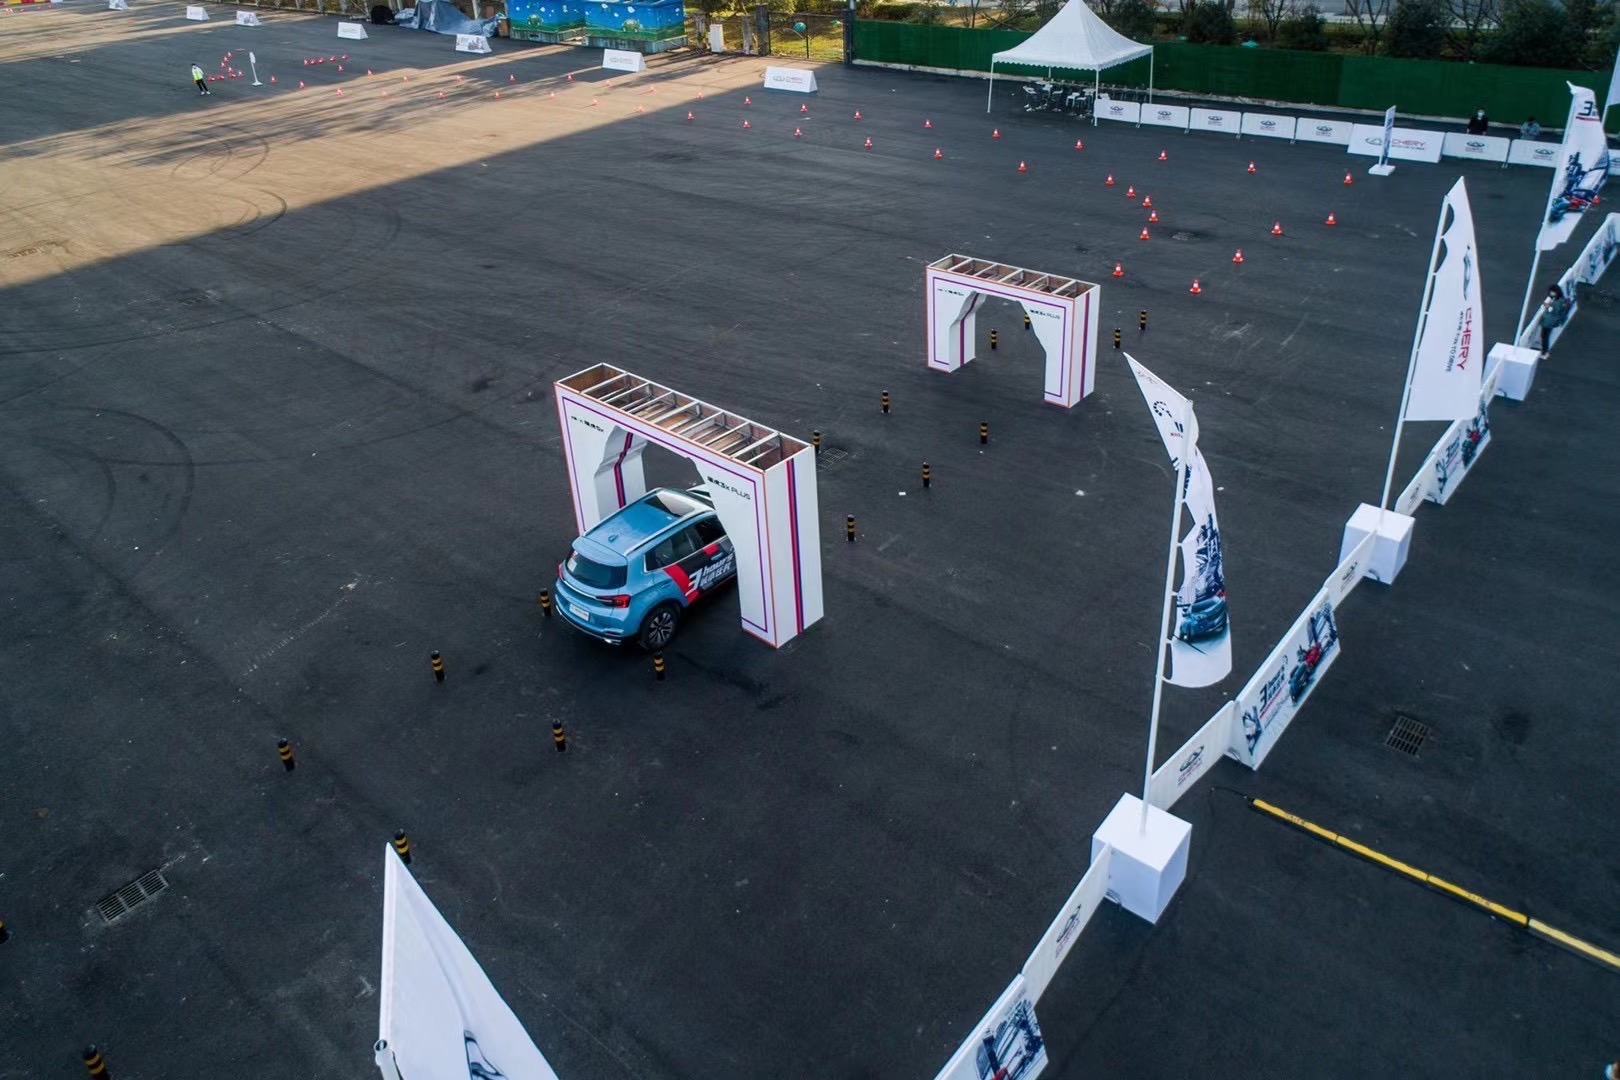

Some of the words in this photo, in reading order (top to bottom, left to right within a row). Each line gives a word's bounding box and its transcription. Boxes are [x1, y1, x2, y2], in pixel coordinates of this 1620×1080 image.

[1577, 101, 1593, 116] 3
[1457, 307, 1472, 370] CHERY
[731, 486, 751, 500] PLUS
[685, 568, 704, 597] 3
